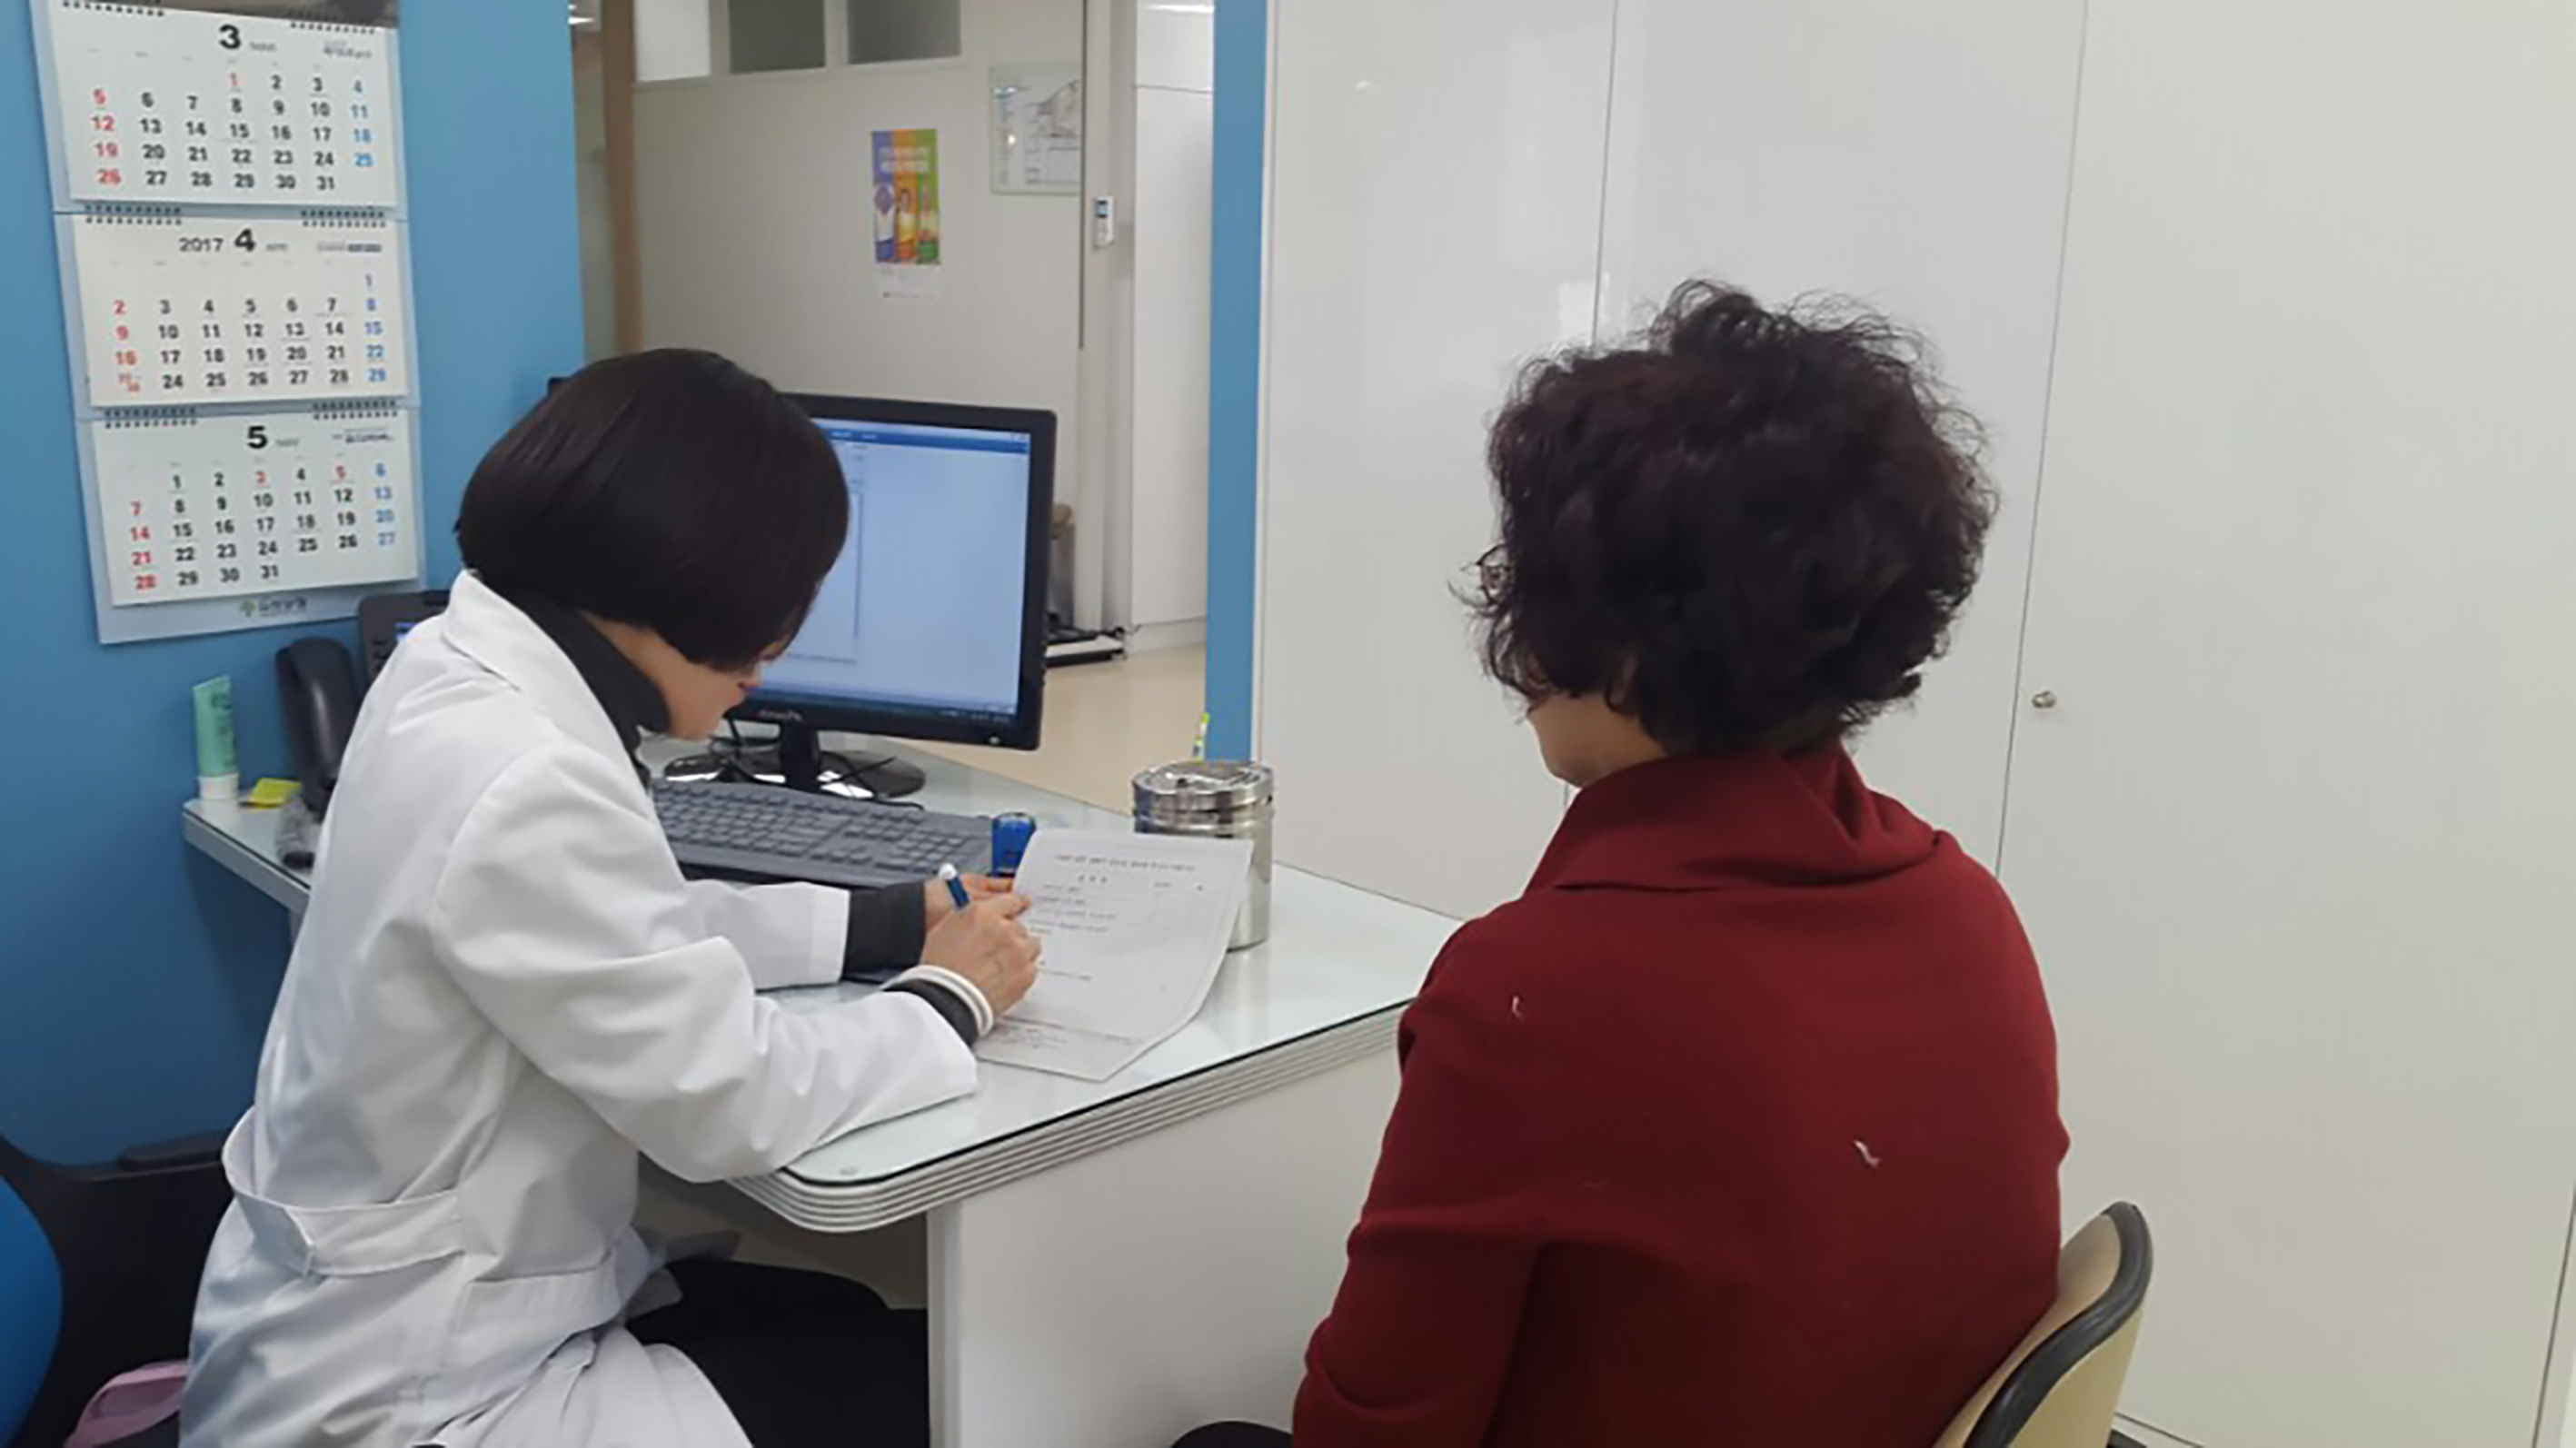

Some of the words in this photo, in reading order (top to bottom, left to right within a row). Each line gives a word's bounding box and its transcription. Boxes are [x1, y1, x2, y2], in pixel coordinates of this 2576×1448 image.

[218, 23, 243, 51] 3
[230, 72, 238, 87] 1
[270, 73, 283, 92] 2
[312, 75, 324, 94] 3
[93, 88, 106, 105] 5
[141, 92, 154, 108] 6
[186, 94, 198, 111] 7
[231, 97, 244, 114] 8
[273, 99, 285, 116] 9
[310, 101, 331, 118] 10
[91, 114, 114, 132] 12
[139, 117, 163, 134] 13
[185, 120, 208, 137] 14
[229, 123, 251, 139] 15
[272, 124, 292, 141] 16
[313, 125, 333, 143] 17
[94, 142, 118, 158] 19
[141, 143, 166, 161] 20
[187, 145, 208, 163] 21
[231, 147, 253, 164] 22
[273, 149, 294, 165] 23
[313, 151, 334, 167] 24
[144, 169, 168, 186] 27
[190, 171, 213, 188] 28
[234, 173, 255, 189] 29
[275, 174, 297, 190] 30
[316, 174, 335, 191] 31
[178, 236, 224, 253] 2017
[233, 227, 257, 253] 4
[114, 299, 126, 316] 2
[159, 298, 172, 316] 3
[203, 298, 215, 314] 4
[244, 298, 257, 314] 5
[286, 298, 298, 313] 6
[326, 296, 338, 313] 7
[158, 323, 180, 340] 10
[202, 323, 221, 339] 11
[244, 322, 264, 339] 12
[284, 322, 305, 337] 13
[324, 321, 345, 336] 14
[160, 349, 182, 365] 17
[204, 347, 225, 363] 18
[246, 347, 267, 362] 19
[286, 345, 307, 361] 20
[326, 344, 345, 362] 21
[162, 373, 184, 390] 24
[204, 372, 227, 389] 25
[247, 371, 269, 387] 26
[288, 369, 309, 385] 27
[329, 368, 350, 385] 28
[246, 424, 269, 451] 5
[172, 473, 183, 491] 1
[214, 471, 225, 488] 2
[255, 469, 267, 485] 3
[295, 466, 307, 482] 4
[334, 464, 347, 481] 5
[174, 498, 186, 515] 8
[215, 495, 228, 512] 9
[254, 492, 274, 508] 10
[293, 490, 313, 505] 11
[333, 487, 353, 503] 12
[130, 526, 151, 541] 14
[173, 521, 194, 538] 15
[214, 519, 235, 535] 16
[255, 516, 275, 532] 17
[296, 513, 316, 530] 18
[336, 511, 356, 527] 19
[131, 550, 153, 567] 21
[174, 546, 196, 562] 22
[216, 542, 237, 560] 23
[257, 541, 279, 557] 24
[298, 537, 319, 553] 25
[338, 533, 359, 550] 26
[176, 570, 199, 587] 29
[219, 567, 241, 583] 30
[260, 564, 279, 580] 31
